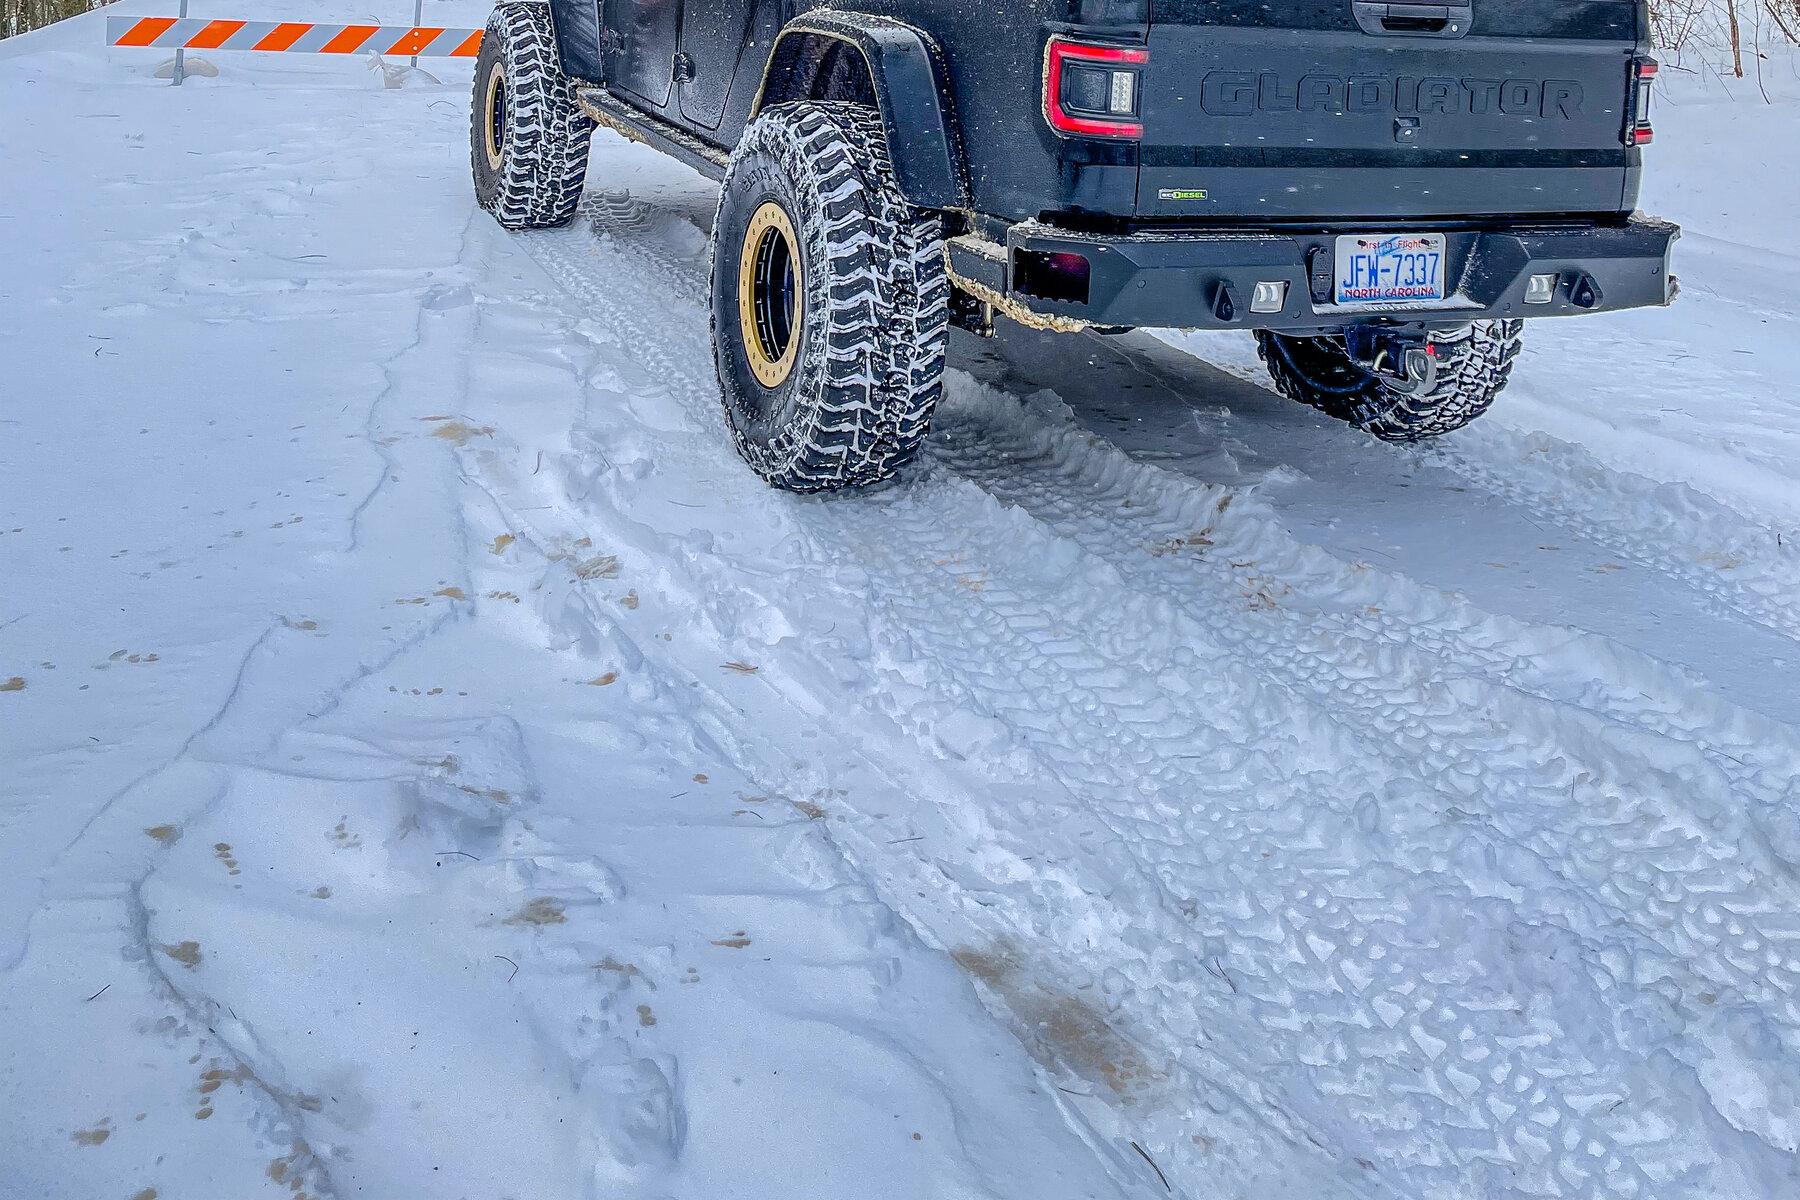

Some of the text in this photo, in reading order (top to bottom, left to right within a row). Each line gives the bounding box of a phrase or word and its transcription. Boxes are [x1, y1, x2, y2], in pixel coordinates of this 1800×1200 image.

[1200, 70, 1585, 120] GLADIATOR
[1343, 253, 1439, 287] JFW-7337
[1345, 287, 1434, 298] NORTH CAROLINA
